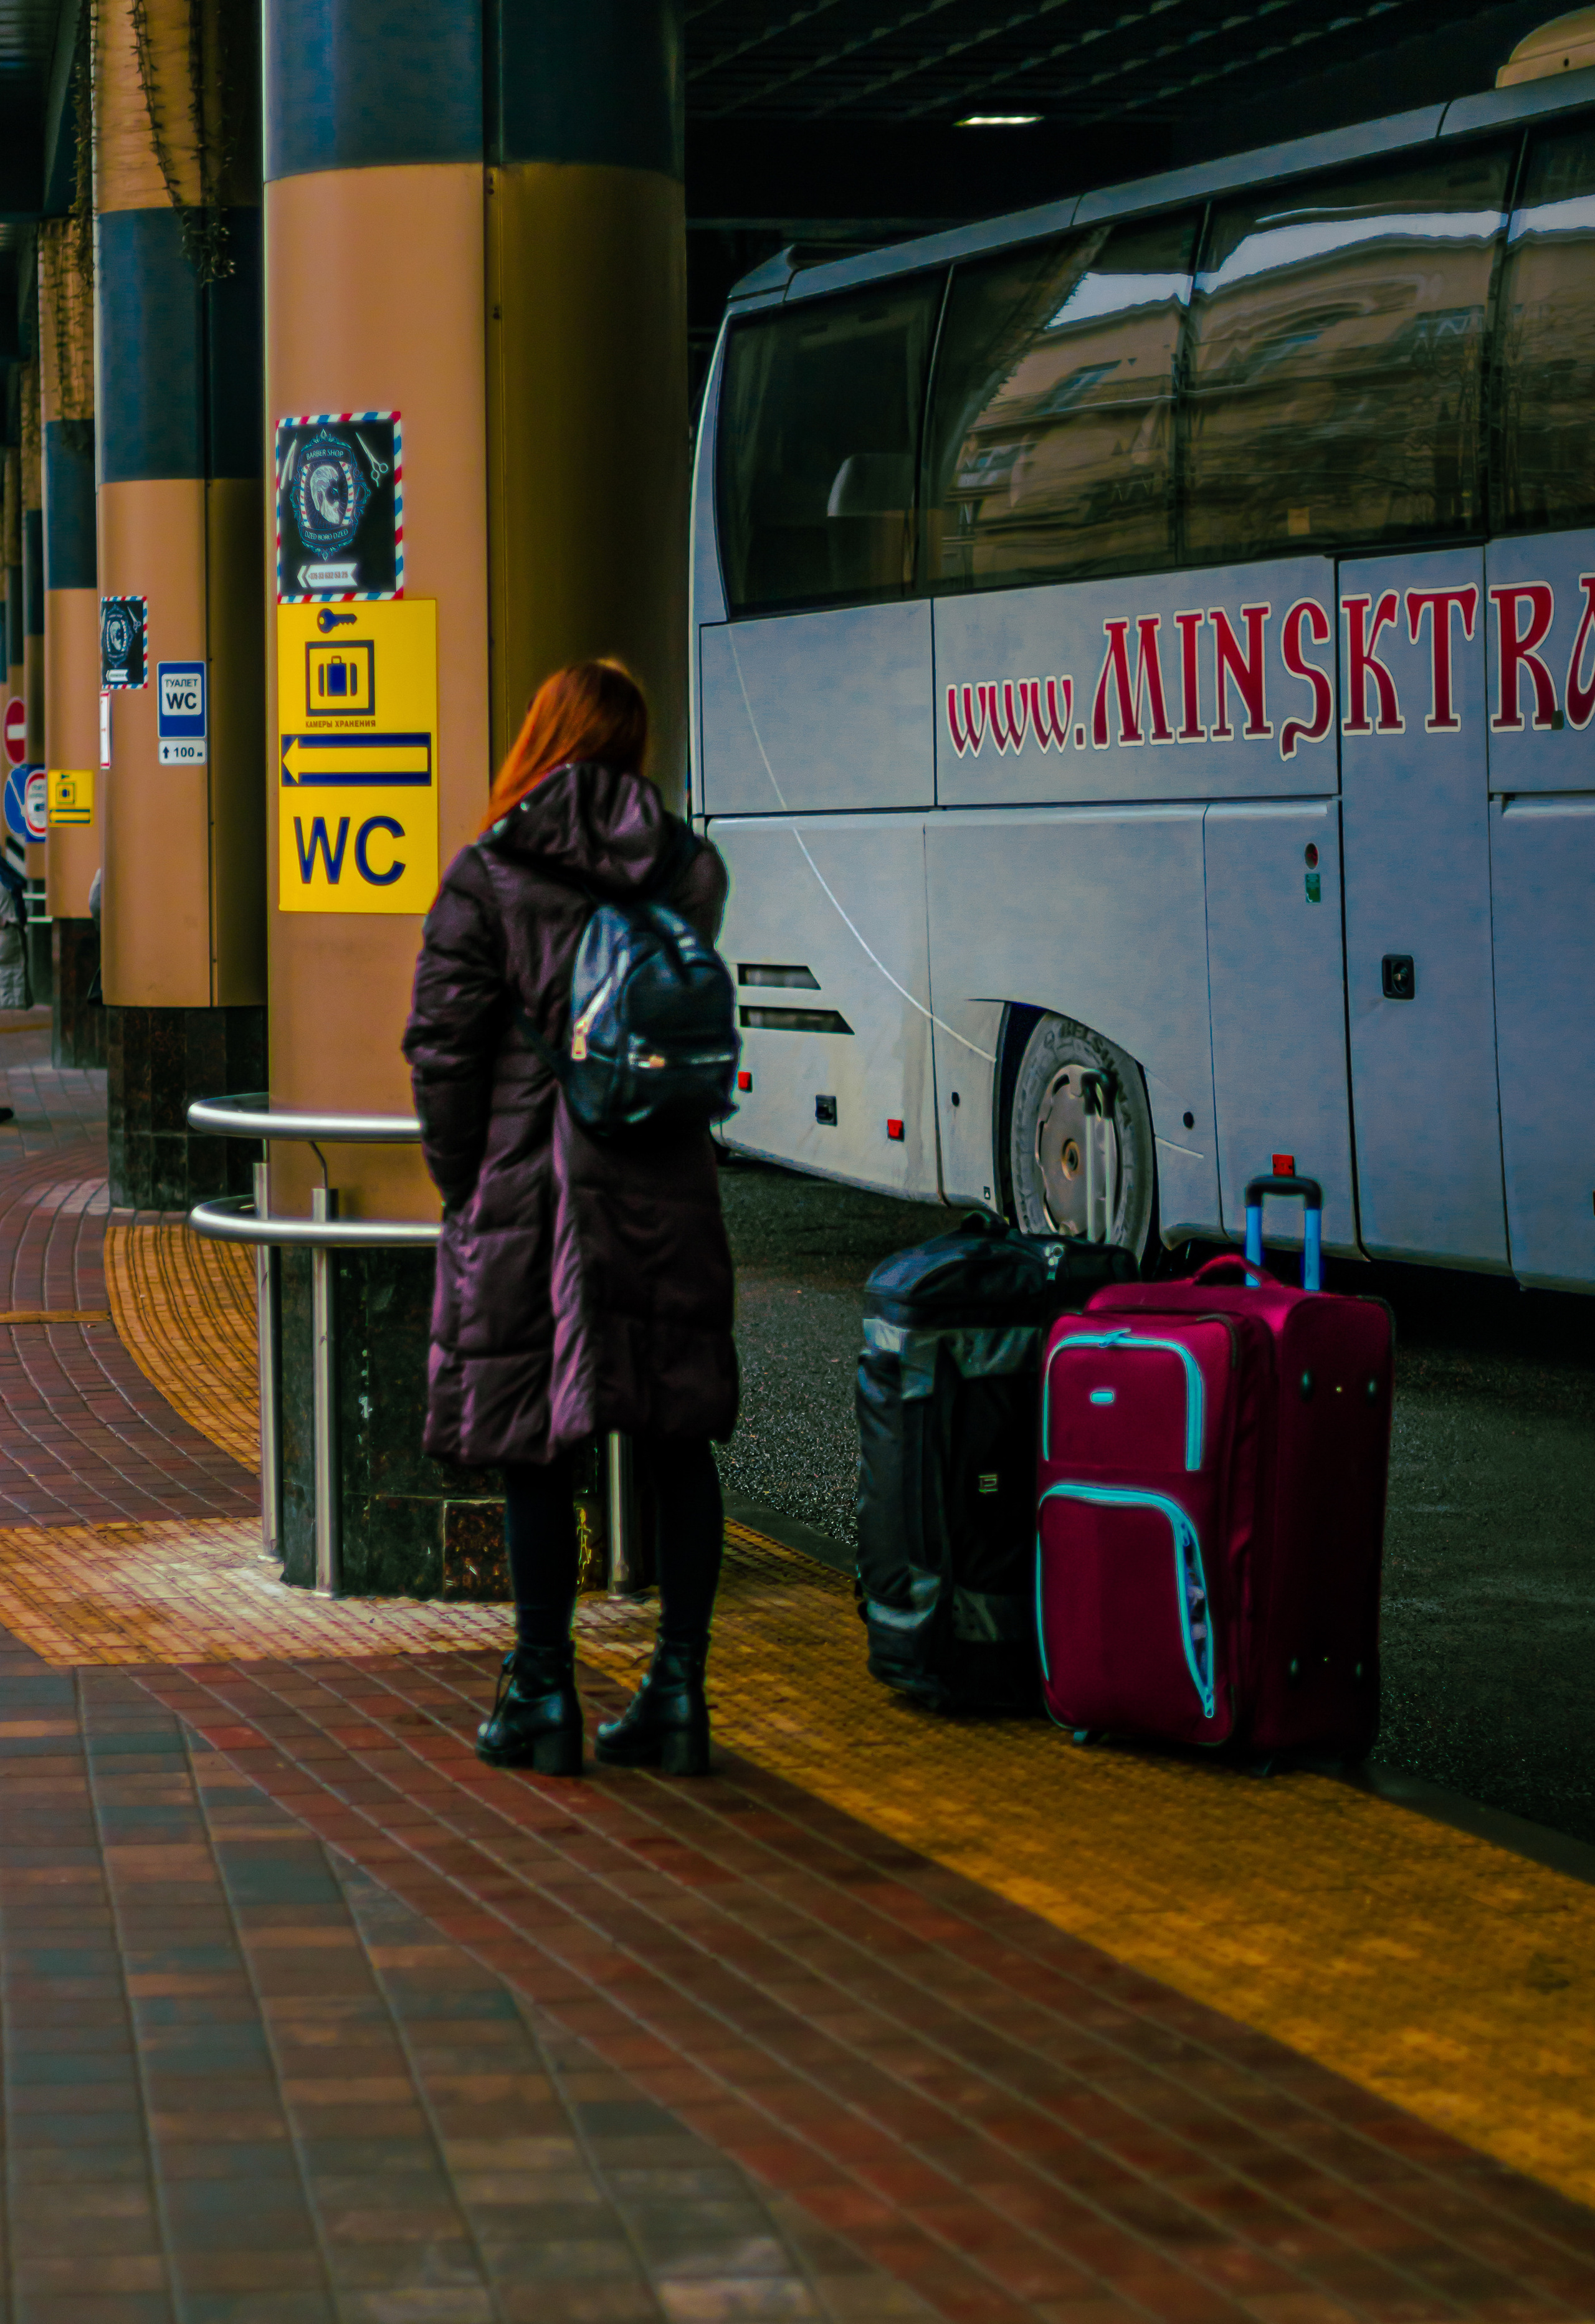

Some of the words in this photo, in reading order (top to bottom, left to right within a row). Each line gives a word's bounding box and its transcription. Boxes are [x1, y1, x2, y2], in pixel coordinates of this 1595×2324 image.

[306, 449, 326, 460] BARBER
[327, 449, 344, 457] SHOP
[304, 530, 317, 540] DZED
[333, 529, 348, 539] DZED
[164, 679, 198, 688] ТУАЛЕТ
[166, 692, 197, 710] WC
[305, 720, 333, 728] КАМЕРЫ
[335, 720, 376, 728] ХРАНЕНИЯ
[173, 747, 194, 758] 100
[293, 816, 406, 887] WC
